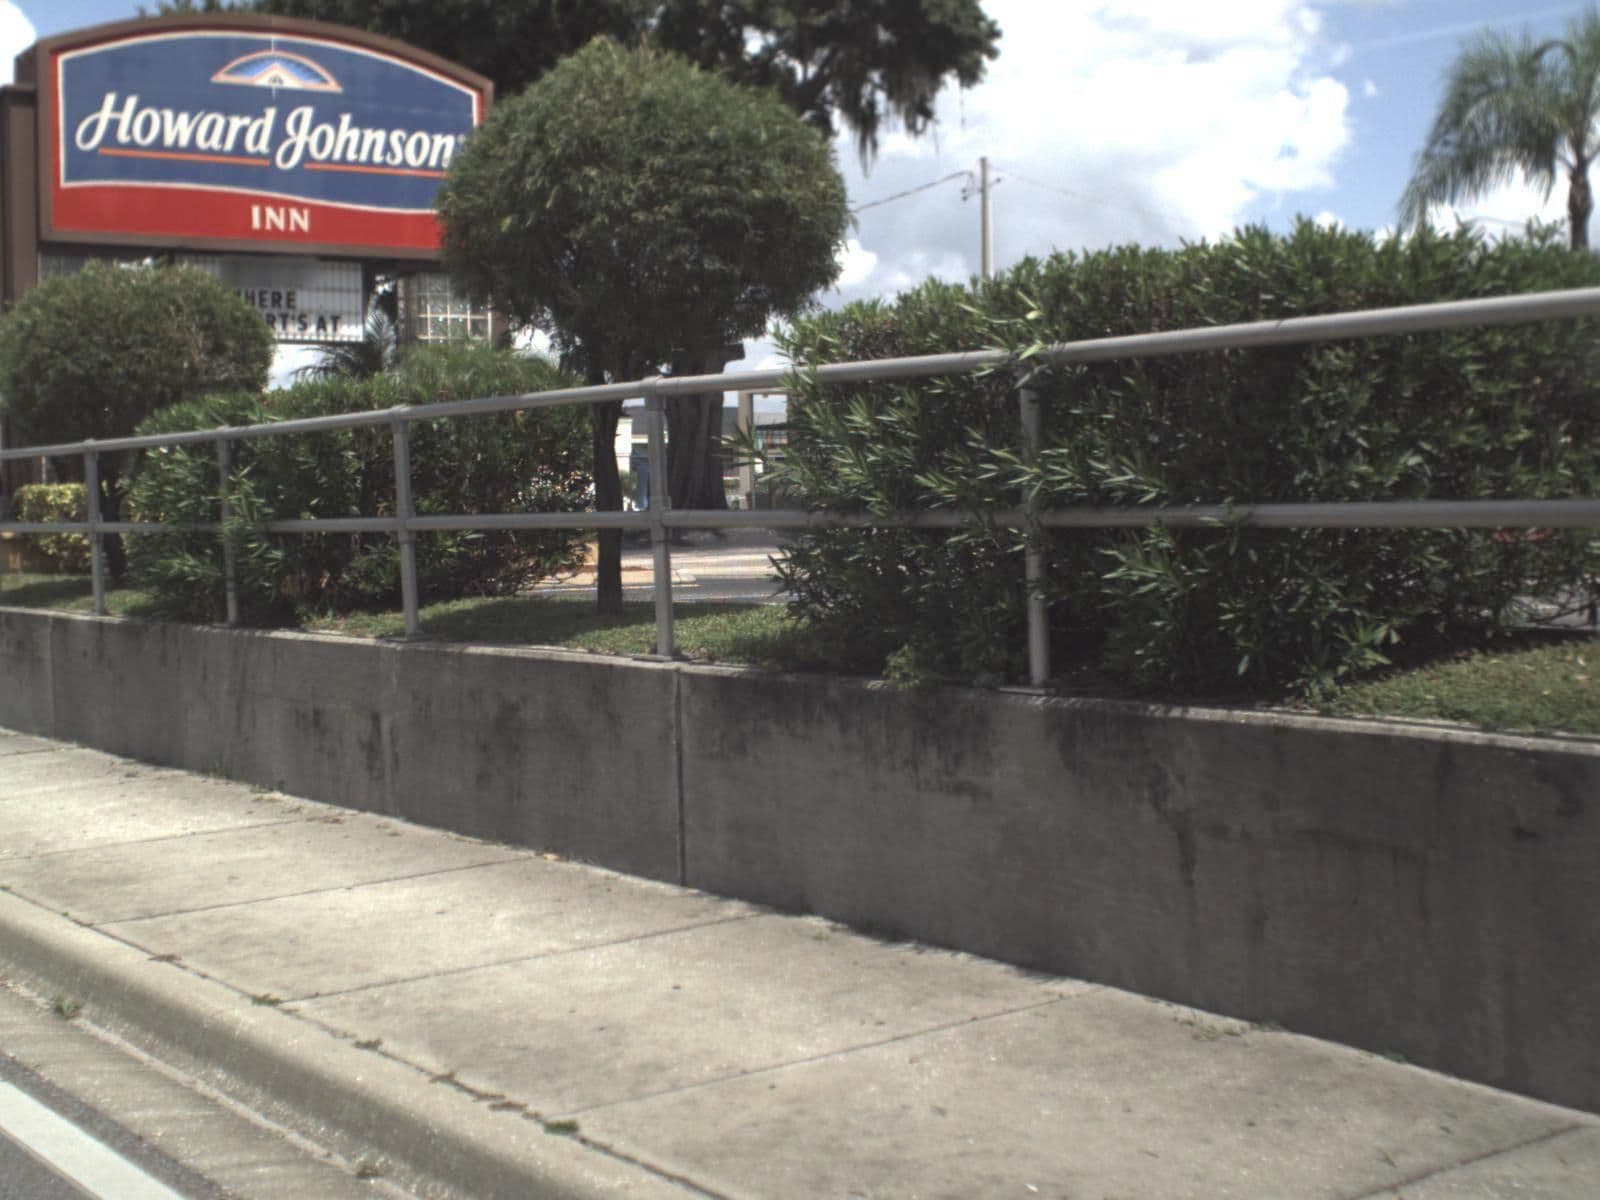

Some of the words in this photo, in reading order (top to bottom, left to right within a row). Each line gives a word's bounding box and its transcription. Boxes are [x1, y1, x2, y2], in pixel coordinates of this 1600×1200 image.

[75, 92, 276, 154] Howard
[275, 106, 455, 170] Johnson
[251, 205, 310, 232] INN
[238, 289, 296, 309] HERE
[316, 314, 341, 332] AT
